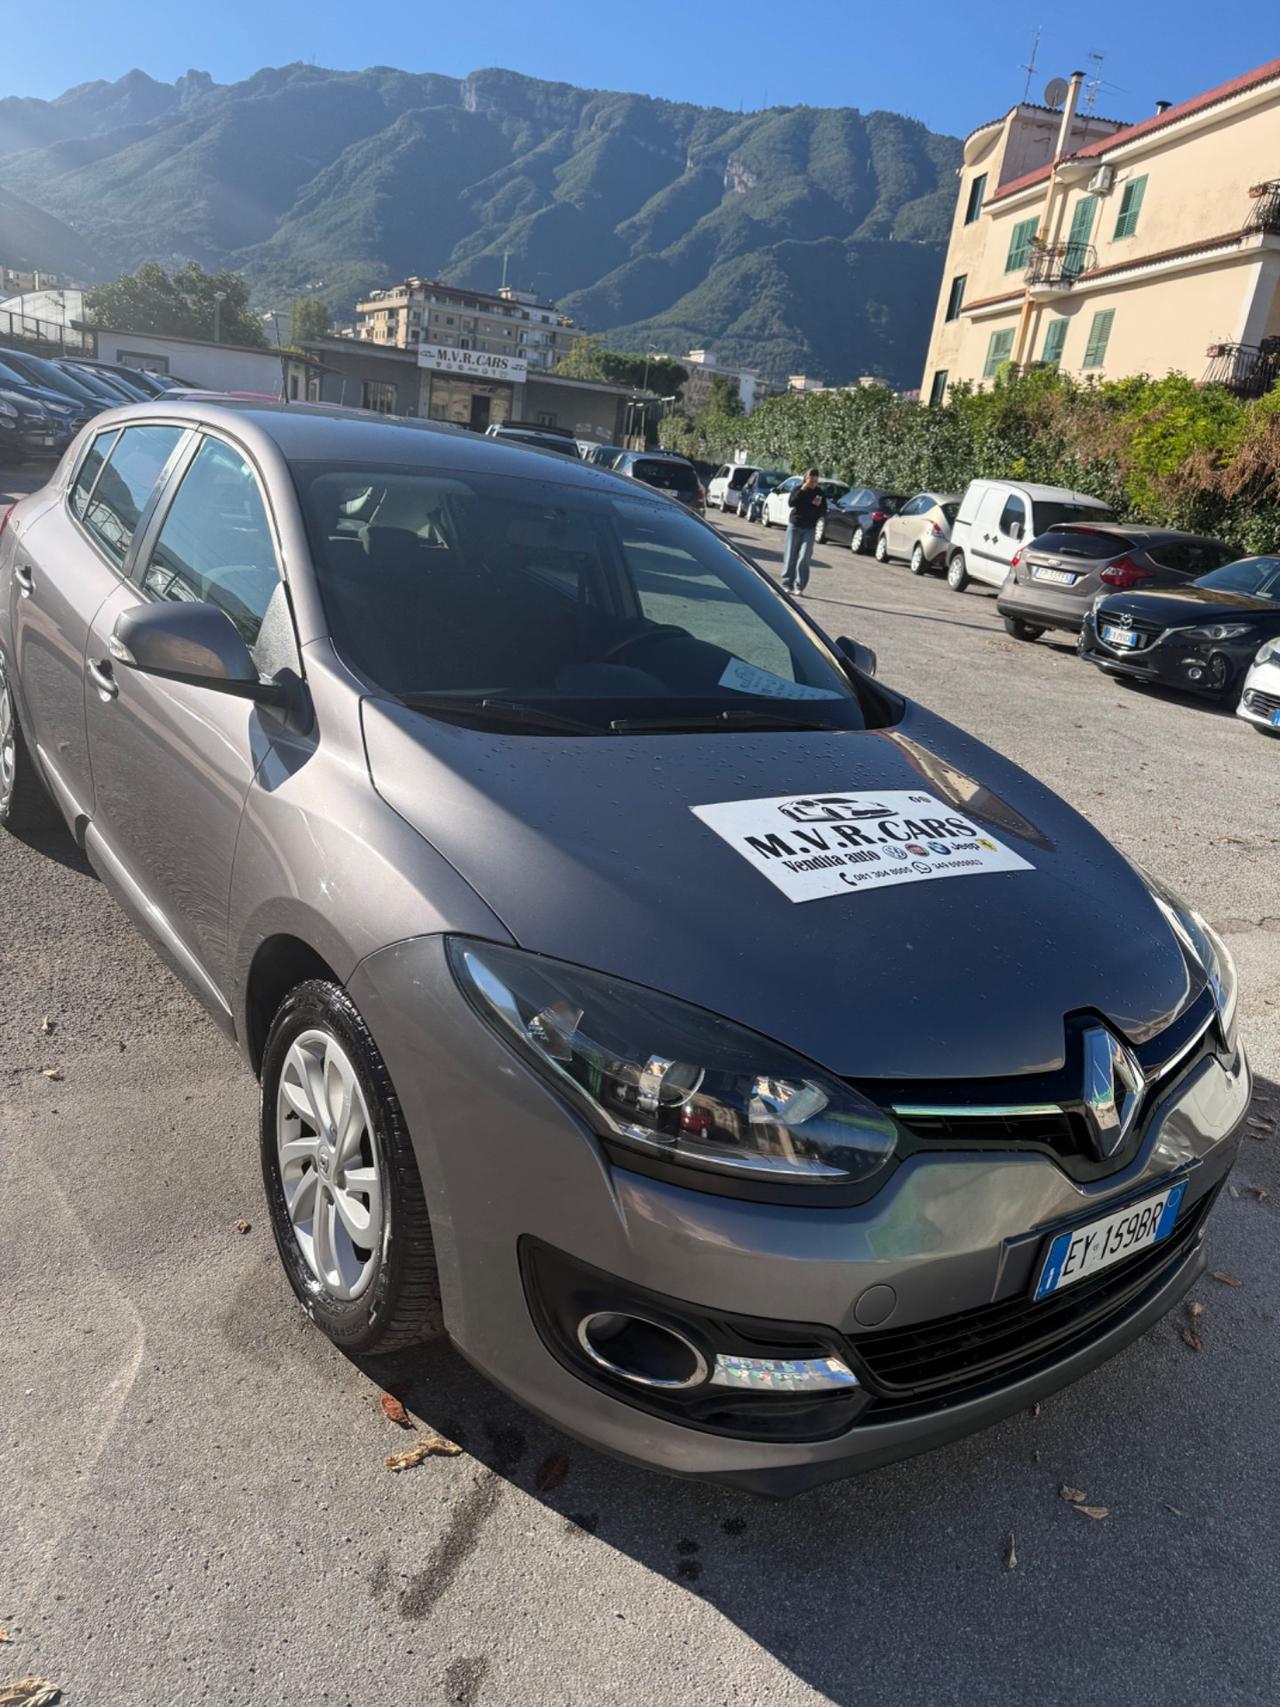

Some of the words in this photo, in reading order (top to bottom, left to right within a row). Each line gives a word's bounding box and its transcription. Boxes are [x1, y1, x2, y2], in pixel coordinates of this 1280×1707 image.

[437, 349, 509, 369] M.V.R.CARS
[744, 817, 977, 859] M.V.R.CARS
[951, 841, 981, 851] Jeep
[782, 852, 847, 873] Vendita
[844, 849, 881, 865] auto
